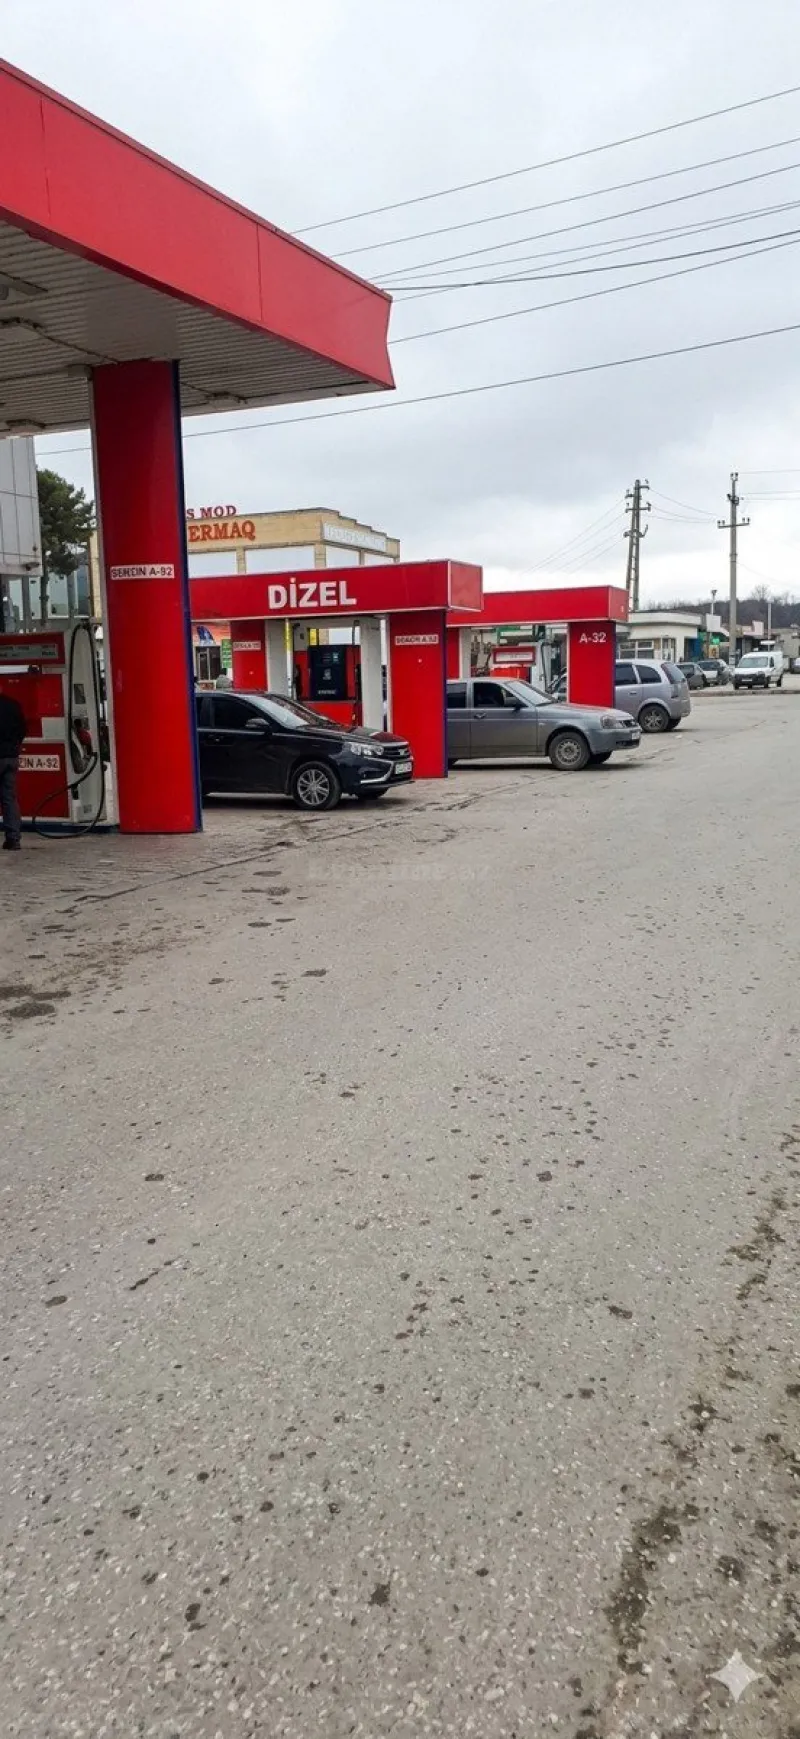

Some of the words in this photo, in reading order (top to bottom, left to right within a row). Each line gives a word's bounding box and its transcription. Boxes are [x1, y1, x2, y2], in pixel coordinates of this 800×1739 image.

[200, 505, 237, 518] MOD
[188, 520, 256, 542] ERMAQ
[268, 577, 357, 610] DİZEL
